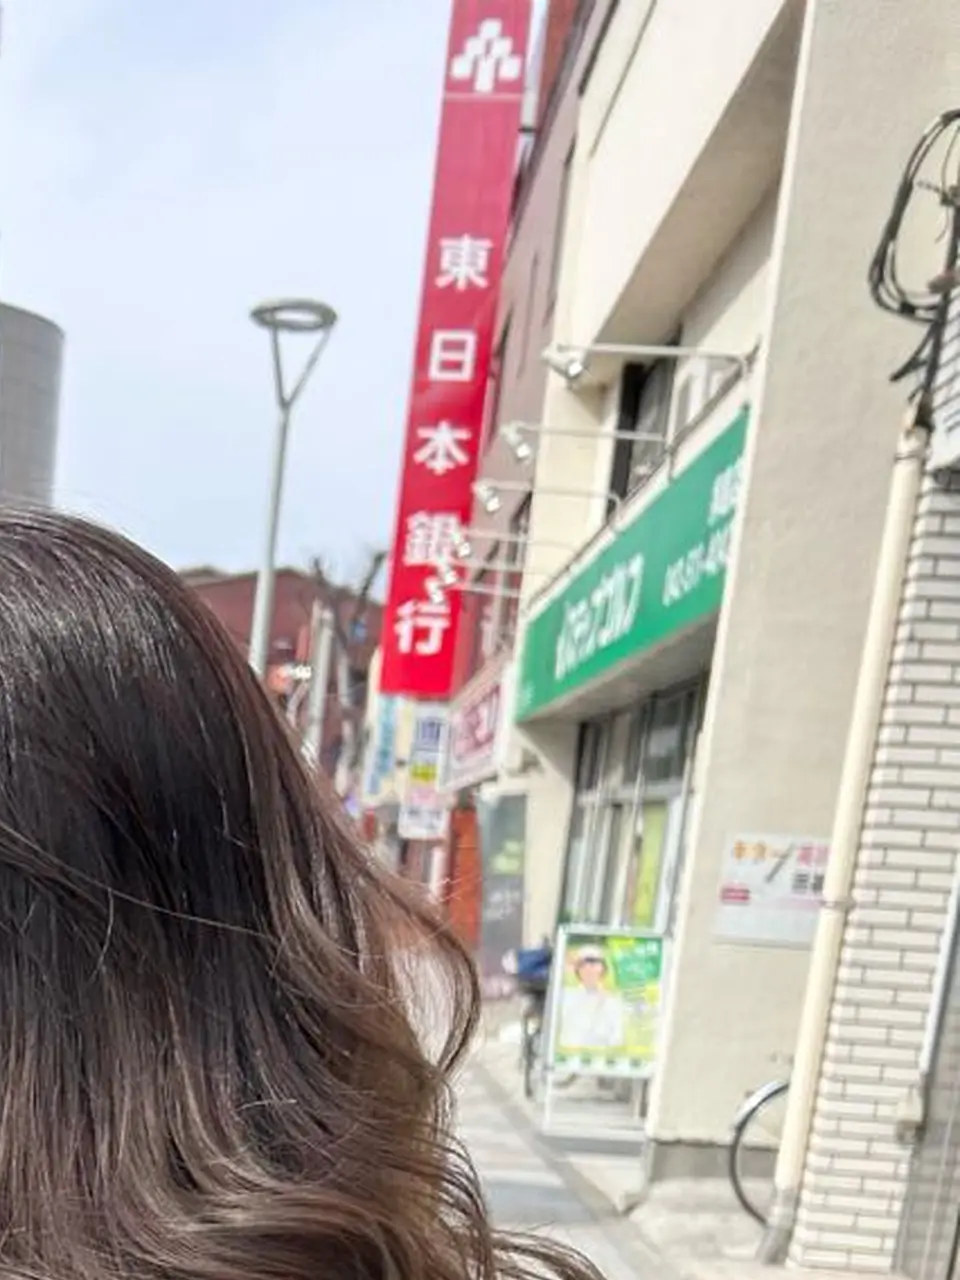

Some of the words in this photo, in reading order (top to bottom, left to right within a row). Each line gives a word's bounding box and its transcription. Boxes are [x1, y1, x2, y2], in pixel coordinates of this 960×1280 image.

[394, 233, 493, 656] 東日本銀行
